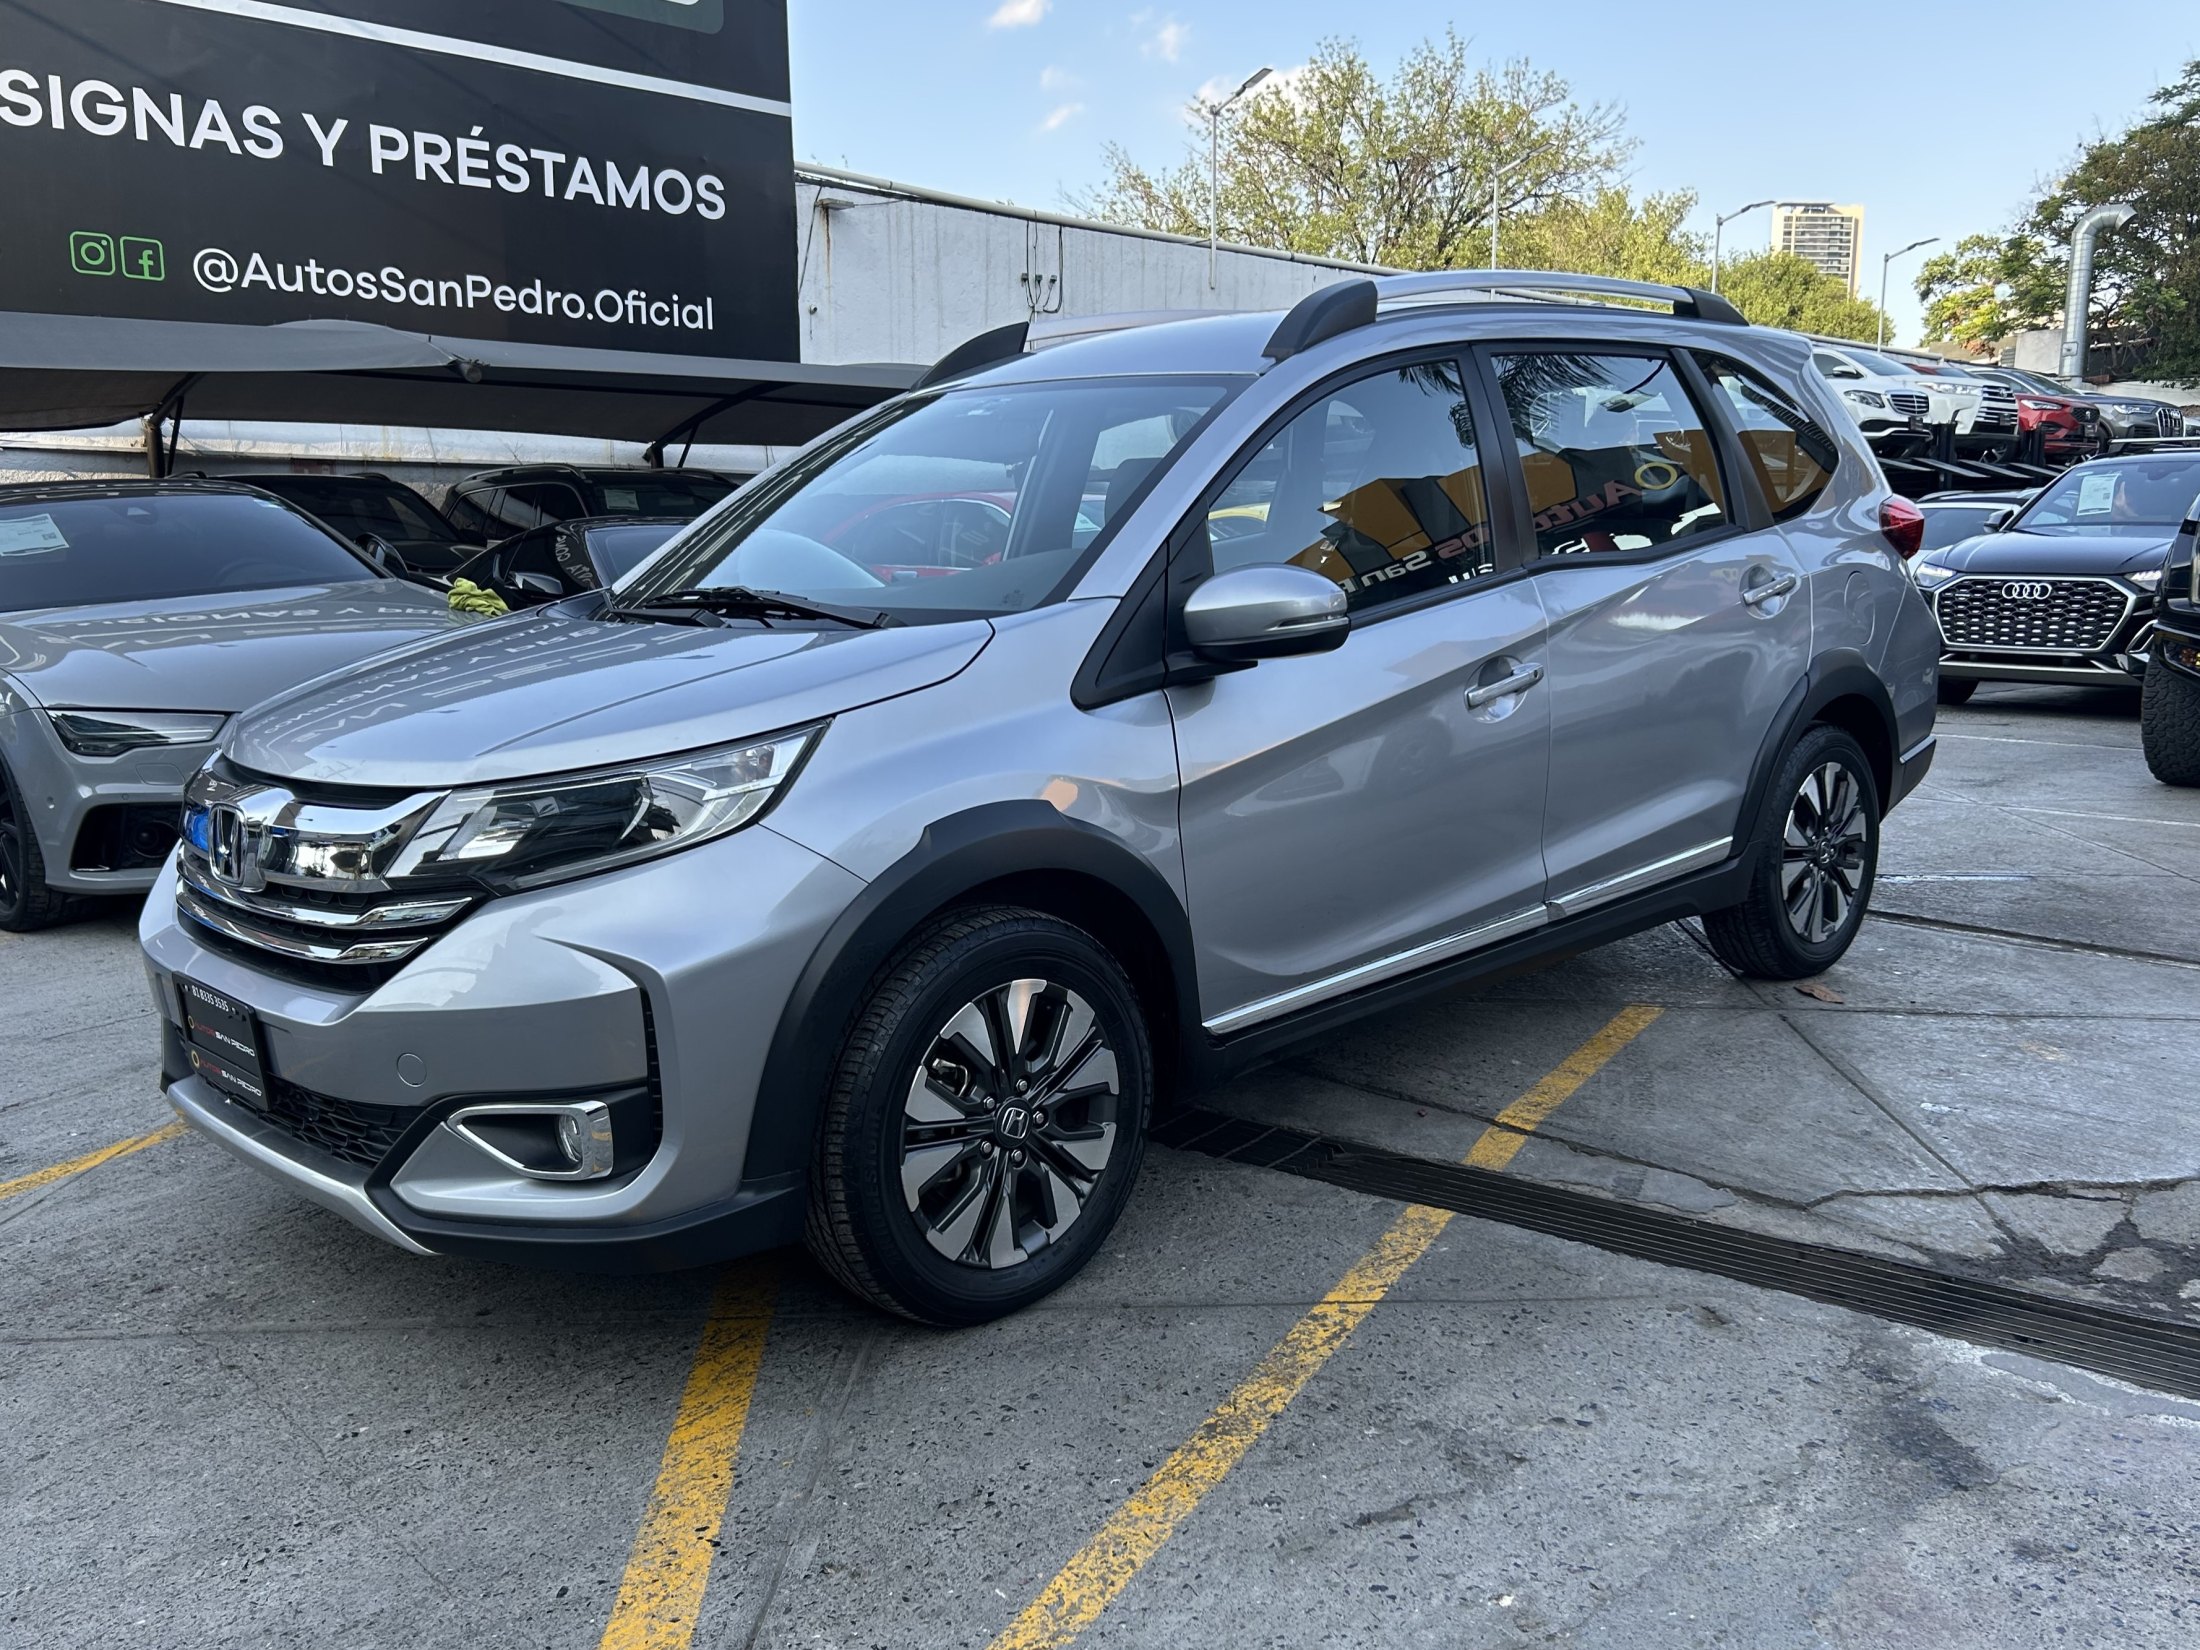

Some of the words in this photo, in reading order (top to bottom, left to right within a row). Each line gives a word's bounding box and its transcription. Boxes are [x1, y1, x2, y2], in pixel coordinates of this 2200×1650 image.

[0, 69, 284, 160] SIGNAS
[301, 113, 349, 167] Y
[368, 125, 727, 220] PRÉSTAMOS
[192, 247, 714, 331] @AutosSanPedro.Oficial
